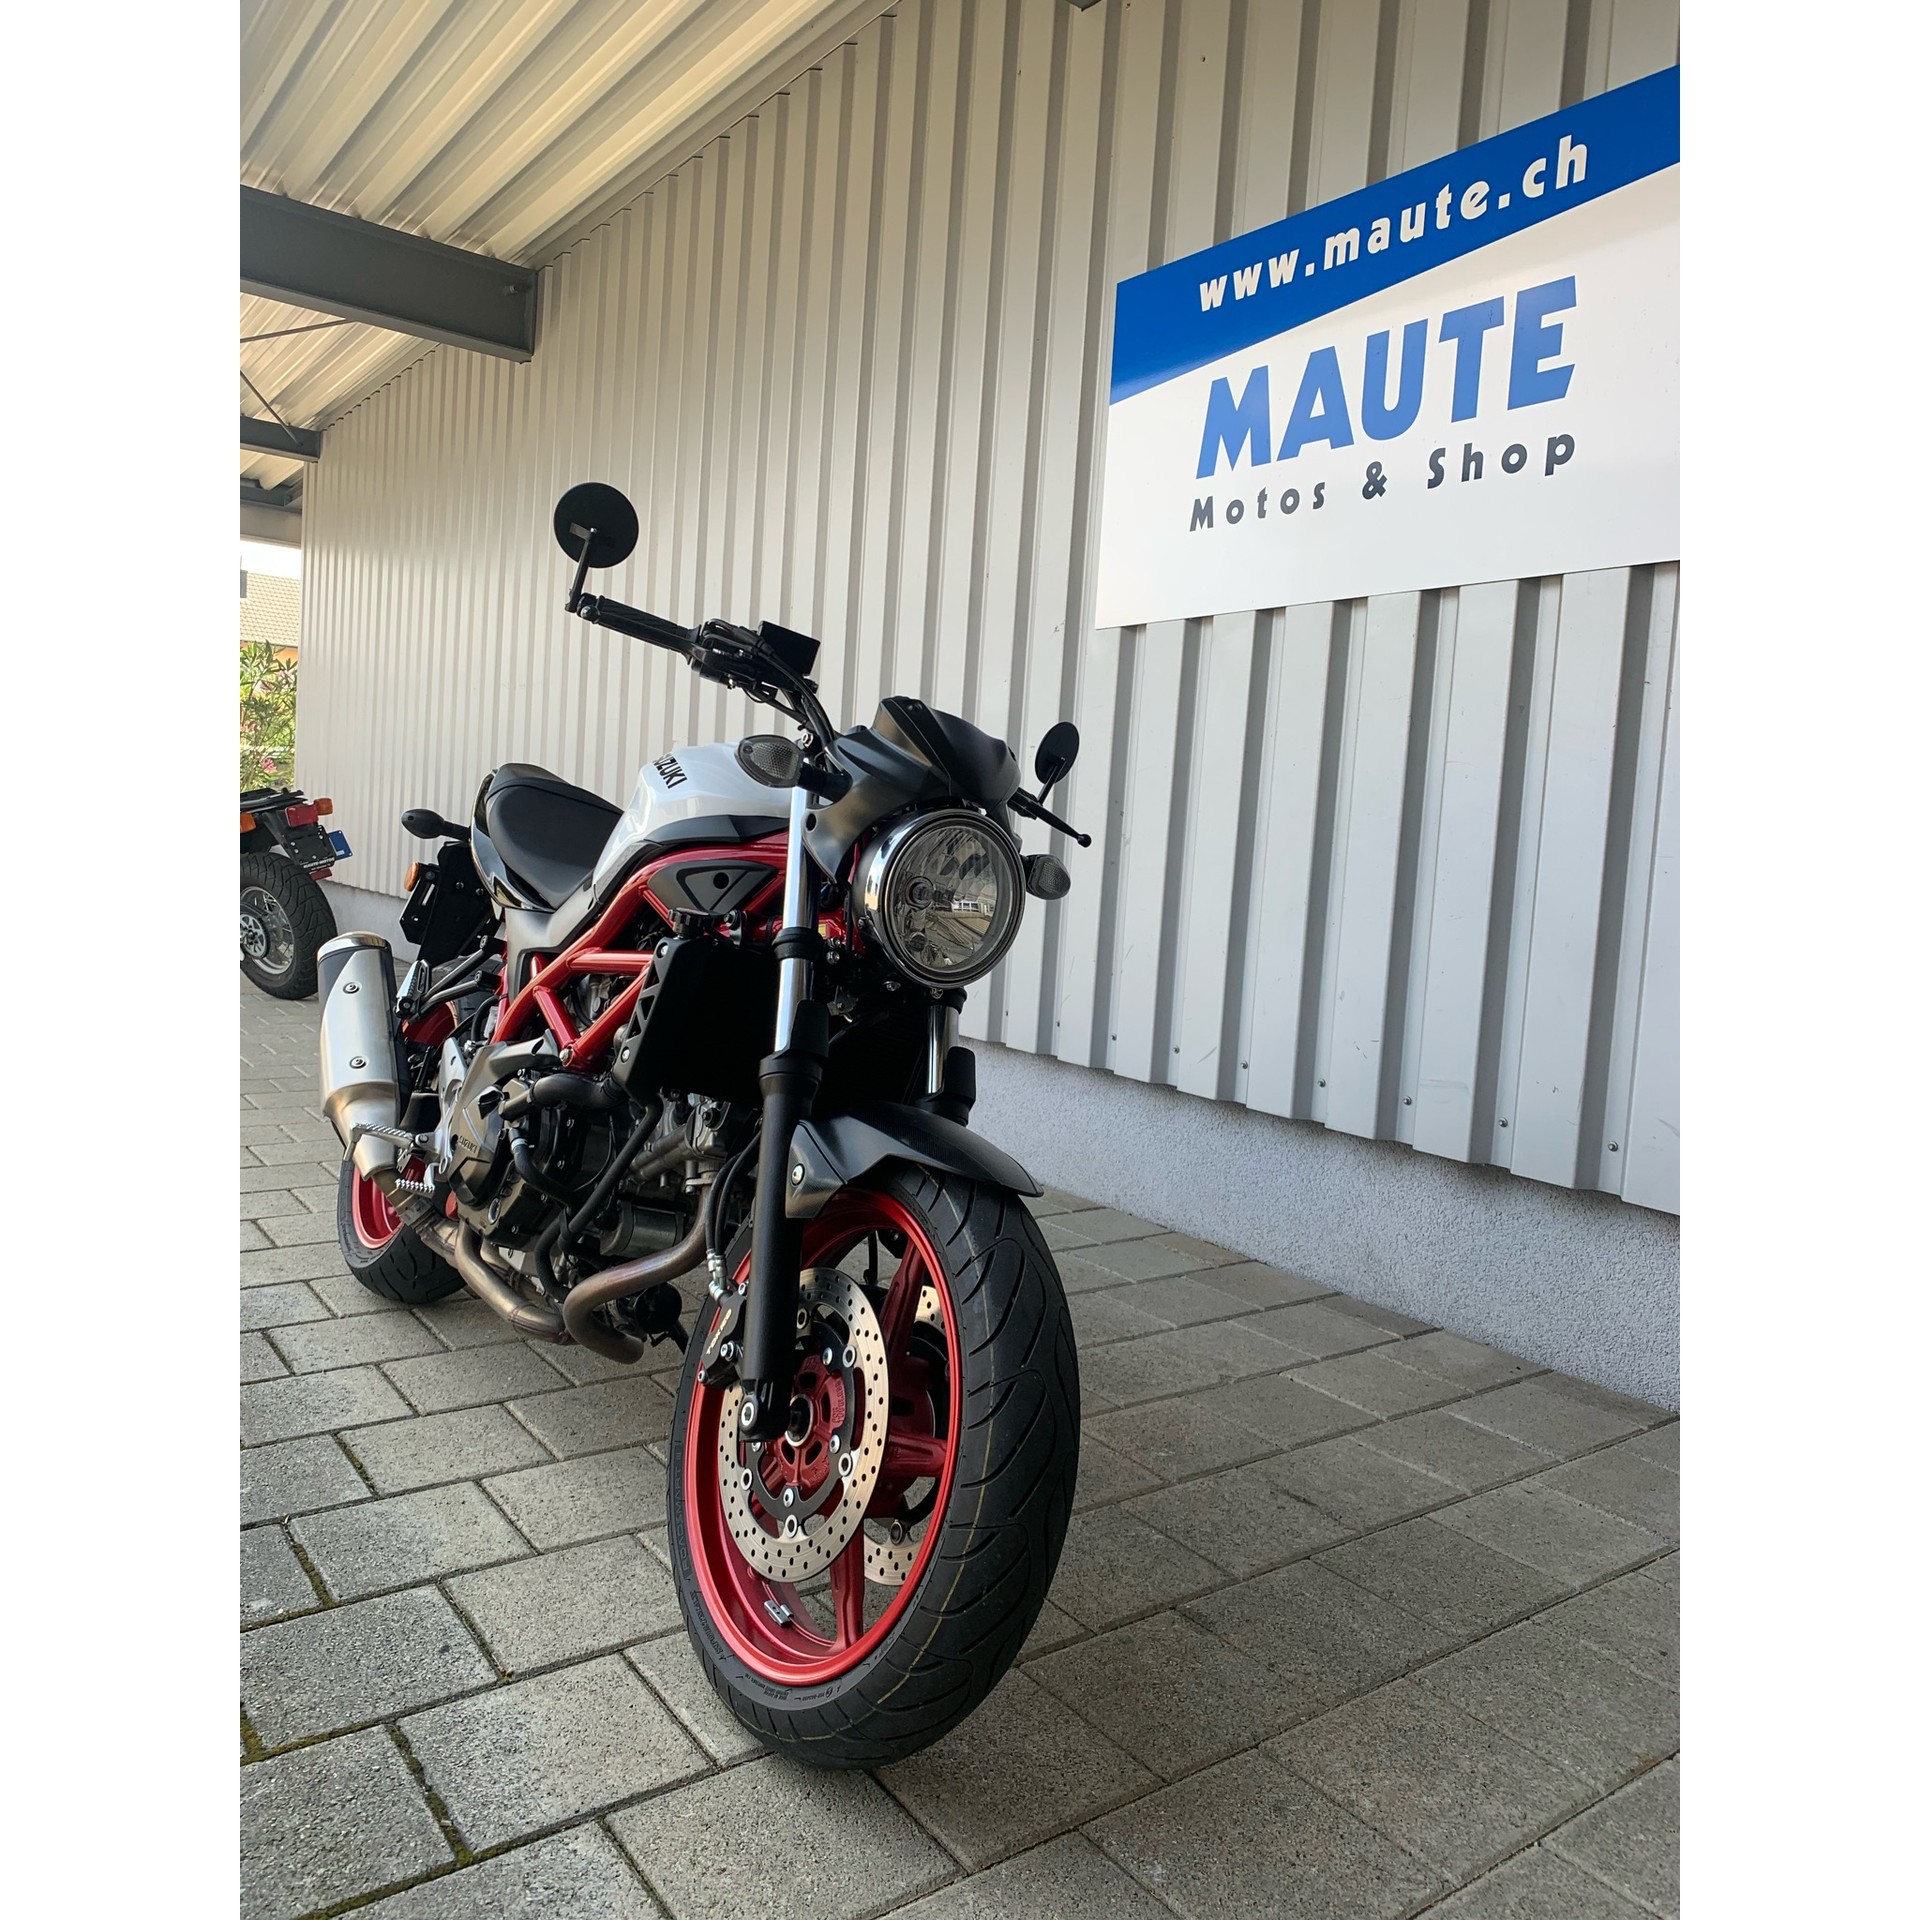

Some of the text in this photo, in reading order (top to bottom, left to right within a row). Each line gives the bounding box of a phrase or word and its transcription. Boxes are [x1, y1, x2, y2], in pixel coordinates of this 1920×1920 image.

[1199, 134, 1588, 312] www.maute.ch
[1196, 275, 1577, 479] MAUTE
[1189, 433, 1575, 532] Motos & Shop
